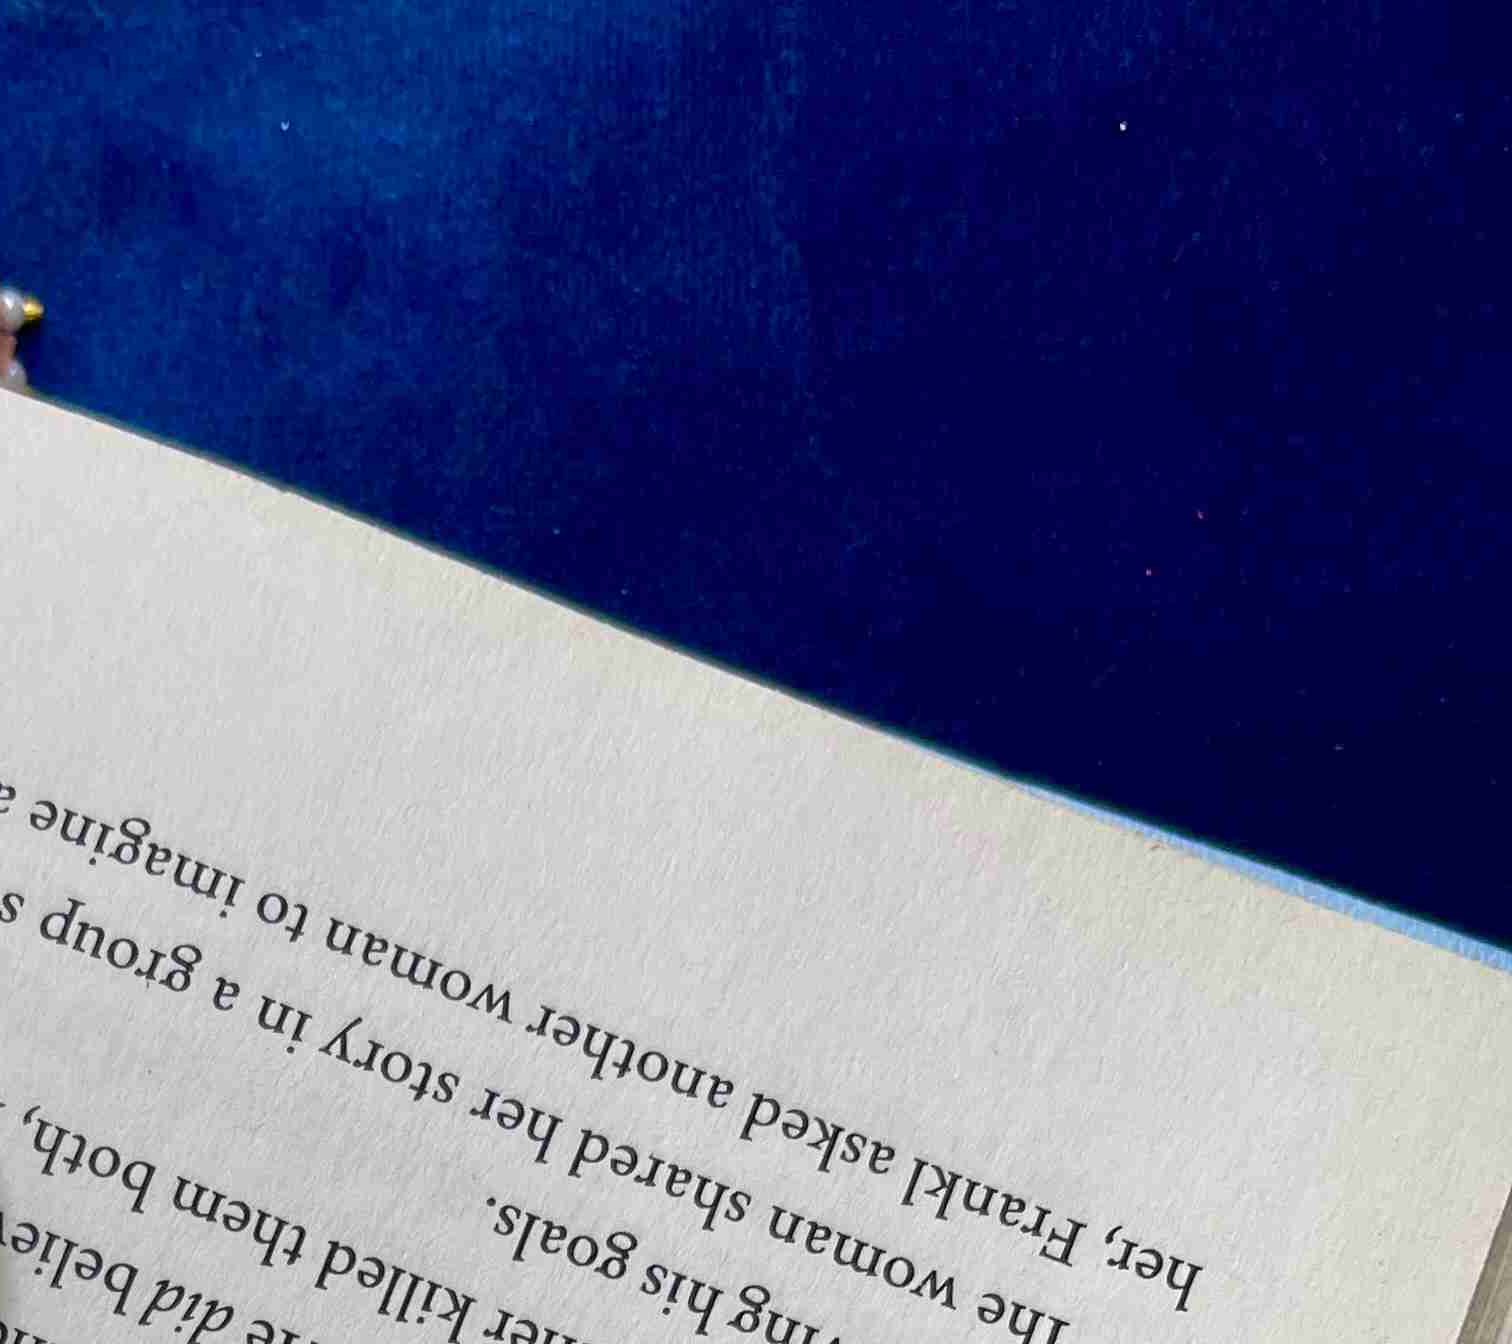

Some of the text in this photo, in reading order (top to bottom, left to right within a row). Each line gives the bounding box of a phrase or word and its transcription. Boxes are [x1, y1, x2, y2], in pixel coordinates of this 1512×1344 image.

[28, 799, 246, 918] imagine
[38, 896, 203, 993] group
[255, 891, 308, 943] to
[211, 975, 241, 1011] a
[324, 916, 512, 1024] woman
[257, 994, 313, 1054] in
[317, 1015, 460, 1104] story
[524, 1003, 735, 1109] another
[21, 1104, 157, 1214] both,
[468, 1086, 564, 1165] her
[738, 1091, 896, 1175] asked
[171, 1174, 307, 1268] them
[566, 1127, 752, 1233] shared
[899, 1156, 1088, 1268] Frankl
[485, 1196, 639, 1280] goals.
[767, 1204, 957, 1311] woman
[1103, 1224, 1204, 1313] her,
[638, 1262, 725, 1337] his
